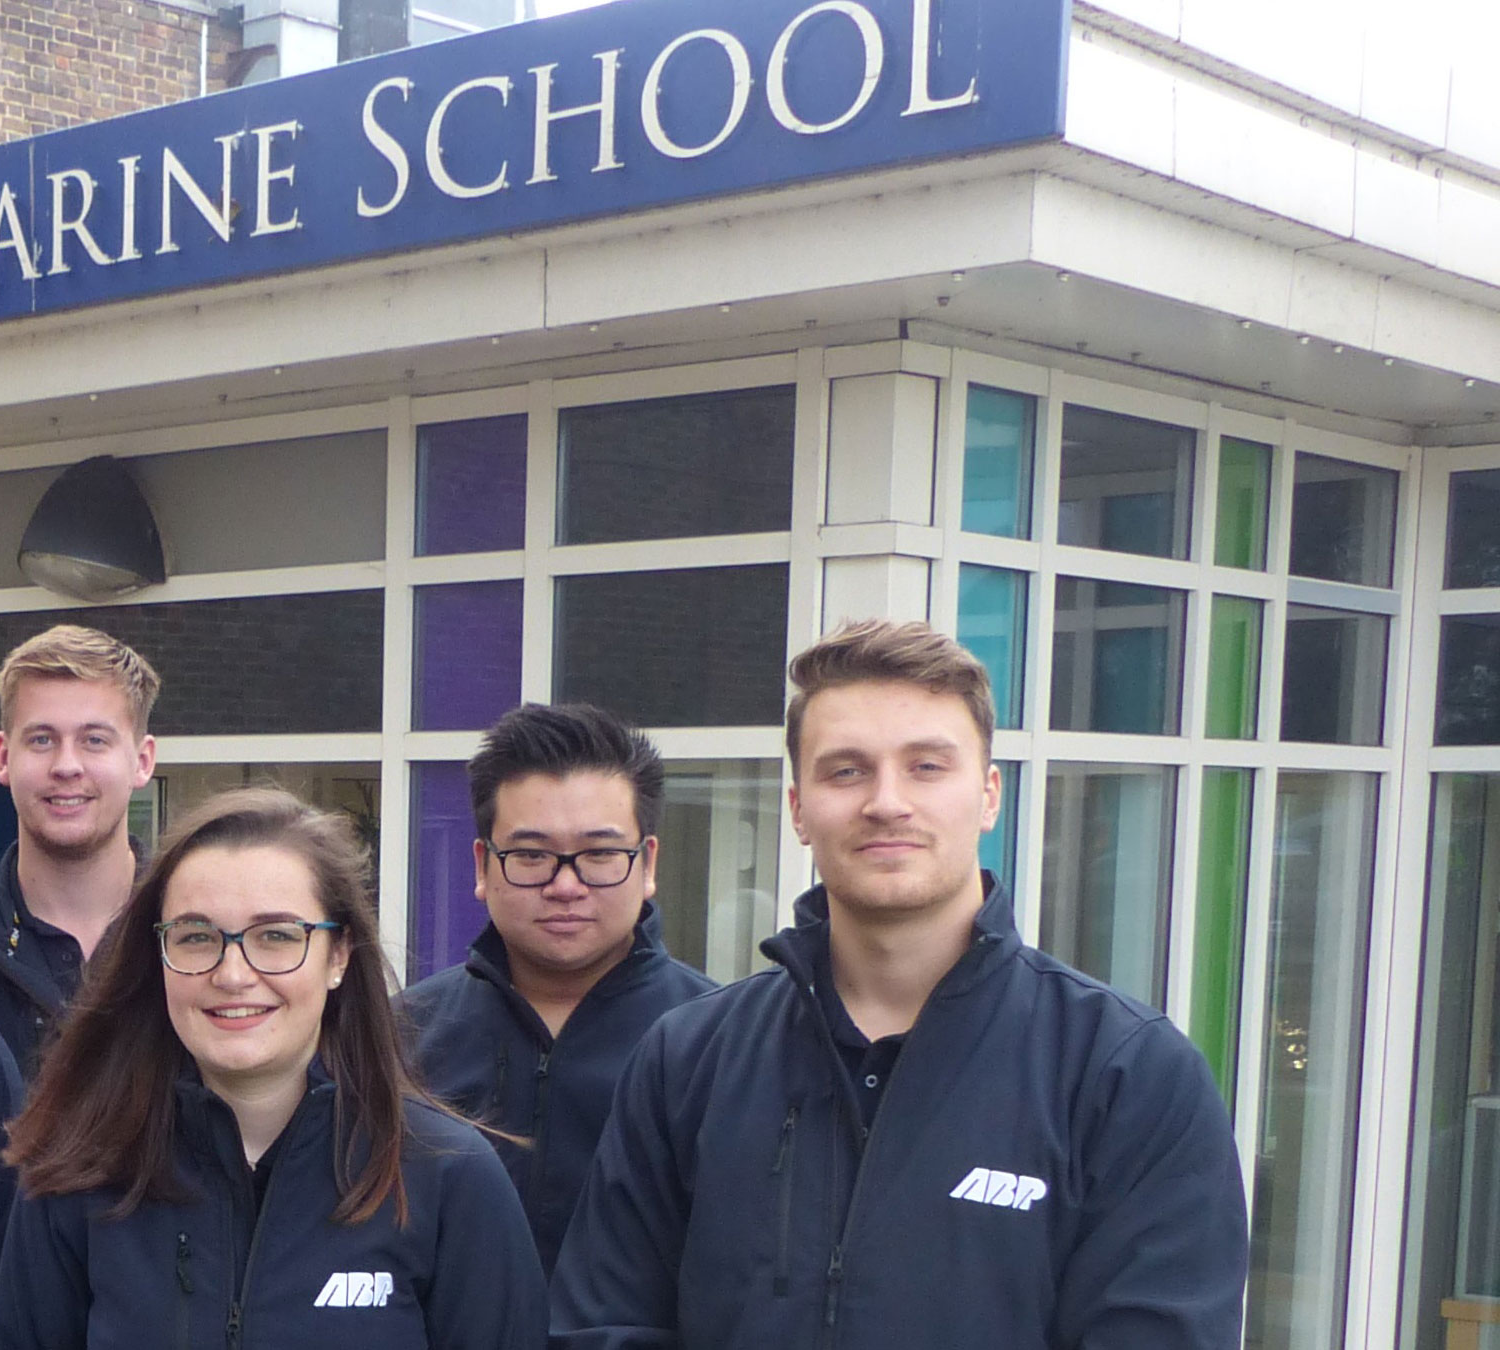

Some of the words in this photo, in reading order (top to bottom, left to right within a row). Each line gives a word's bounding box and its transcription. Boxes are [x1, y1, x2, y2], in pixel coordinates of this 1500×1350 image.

[356, 0, 979, 218] SCHOOL
[949, 1167, 1047, 1211] ABP
[313, 1271, 394, 1307] ABP
